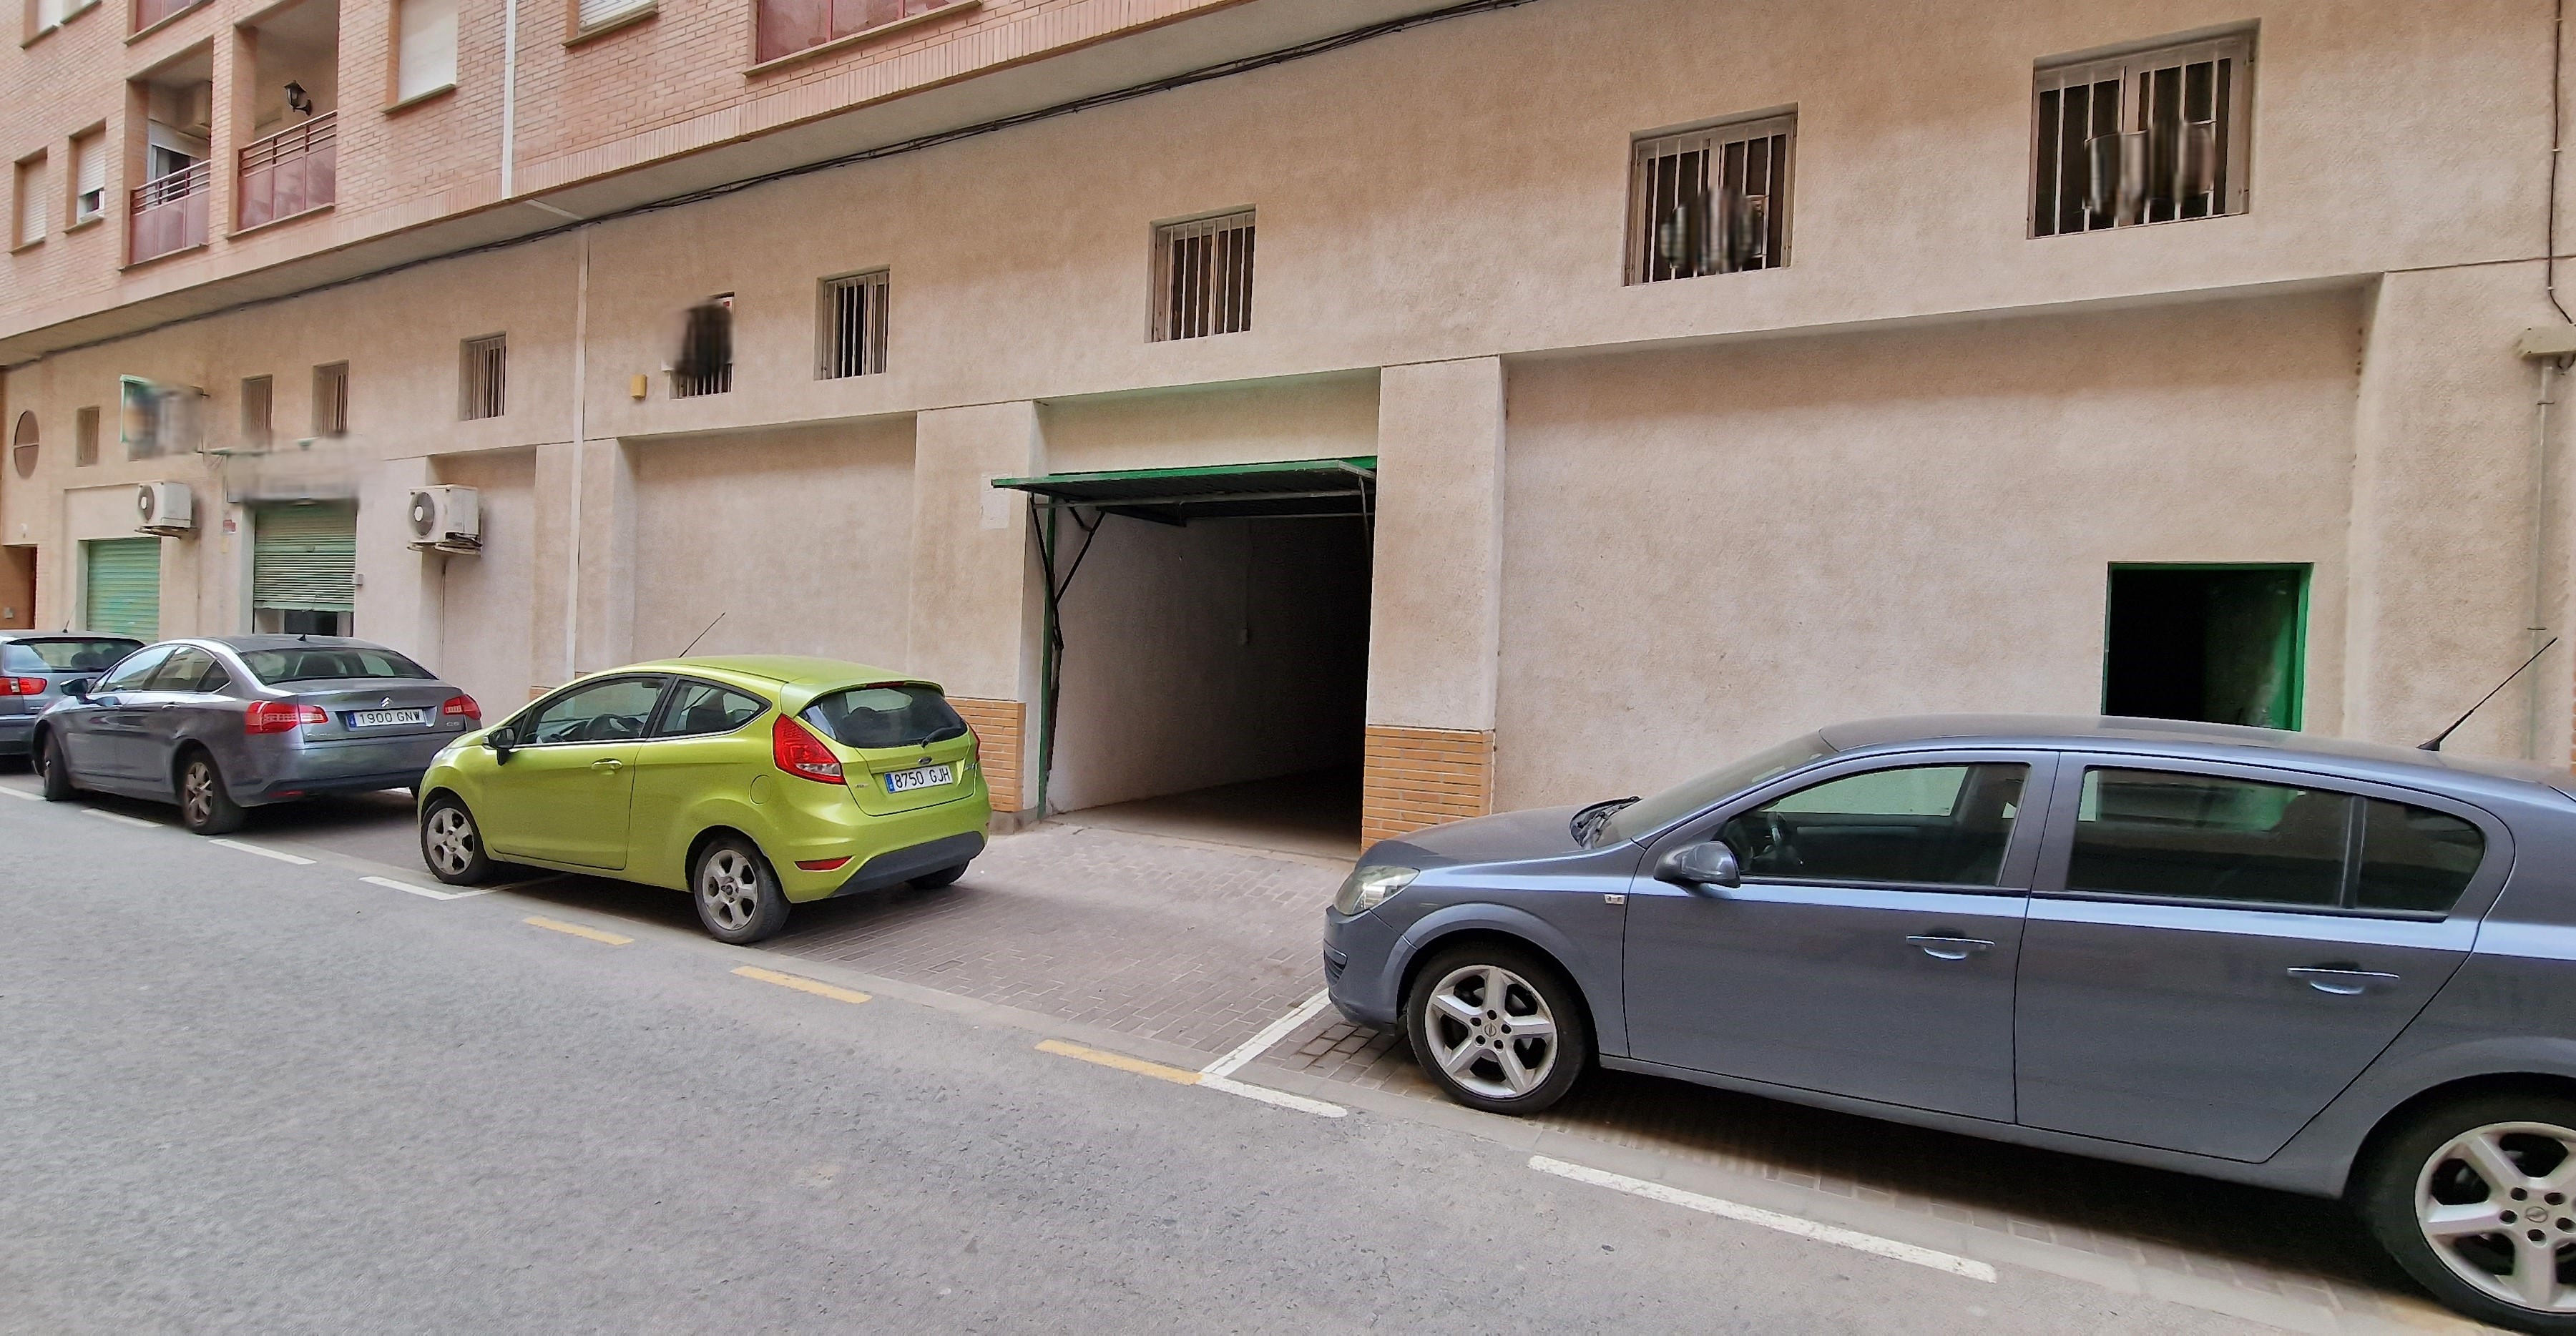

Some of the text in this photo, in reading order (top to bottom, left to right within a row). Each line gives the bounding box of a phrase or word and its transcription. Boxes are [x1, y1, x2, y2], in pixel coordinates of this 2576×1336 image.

[360, 710, 421, 724] 1900 GNW
[894, 767, 951, 789] 8750 GJH
